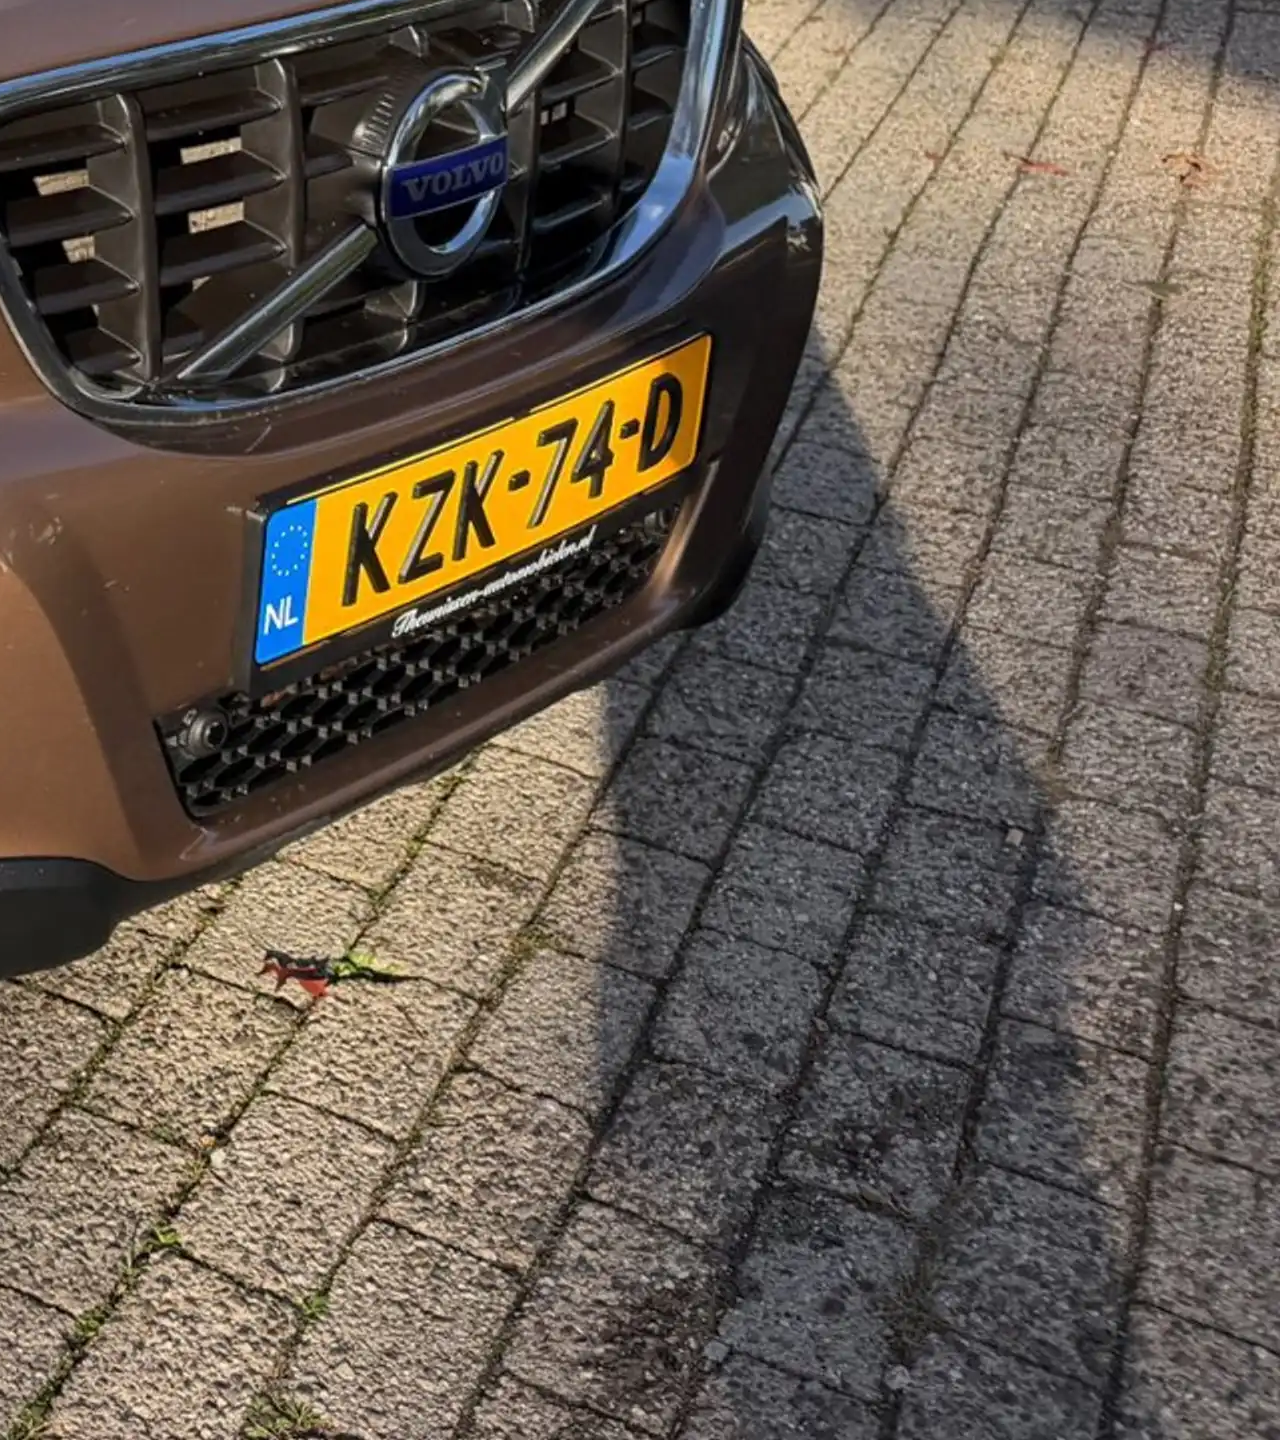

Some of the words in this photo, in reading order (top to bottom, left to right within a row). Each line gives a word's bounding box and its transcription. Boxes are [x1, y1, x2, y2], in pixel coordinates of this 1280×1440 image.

[400, 151, 504, 202] VOLVO
[341, 371, 684, 607] KZK-74-D
[263, 594, 299, 636] NL
